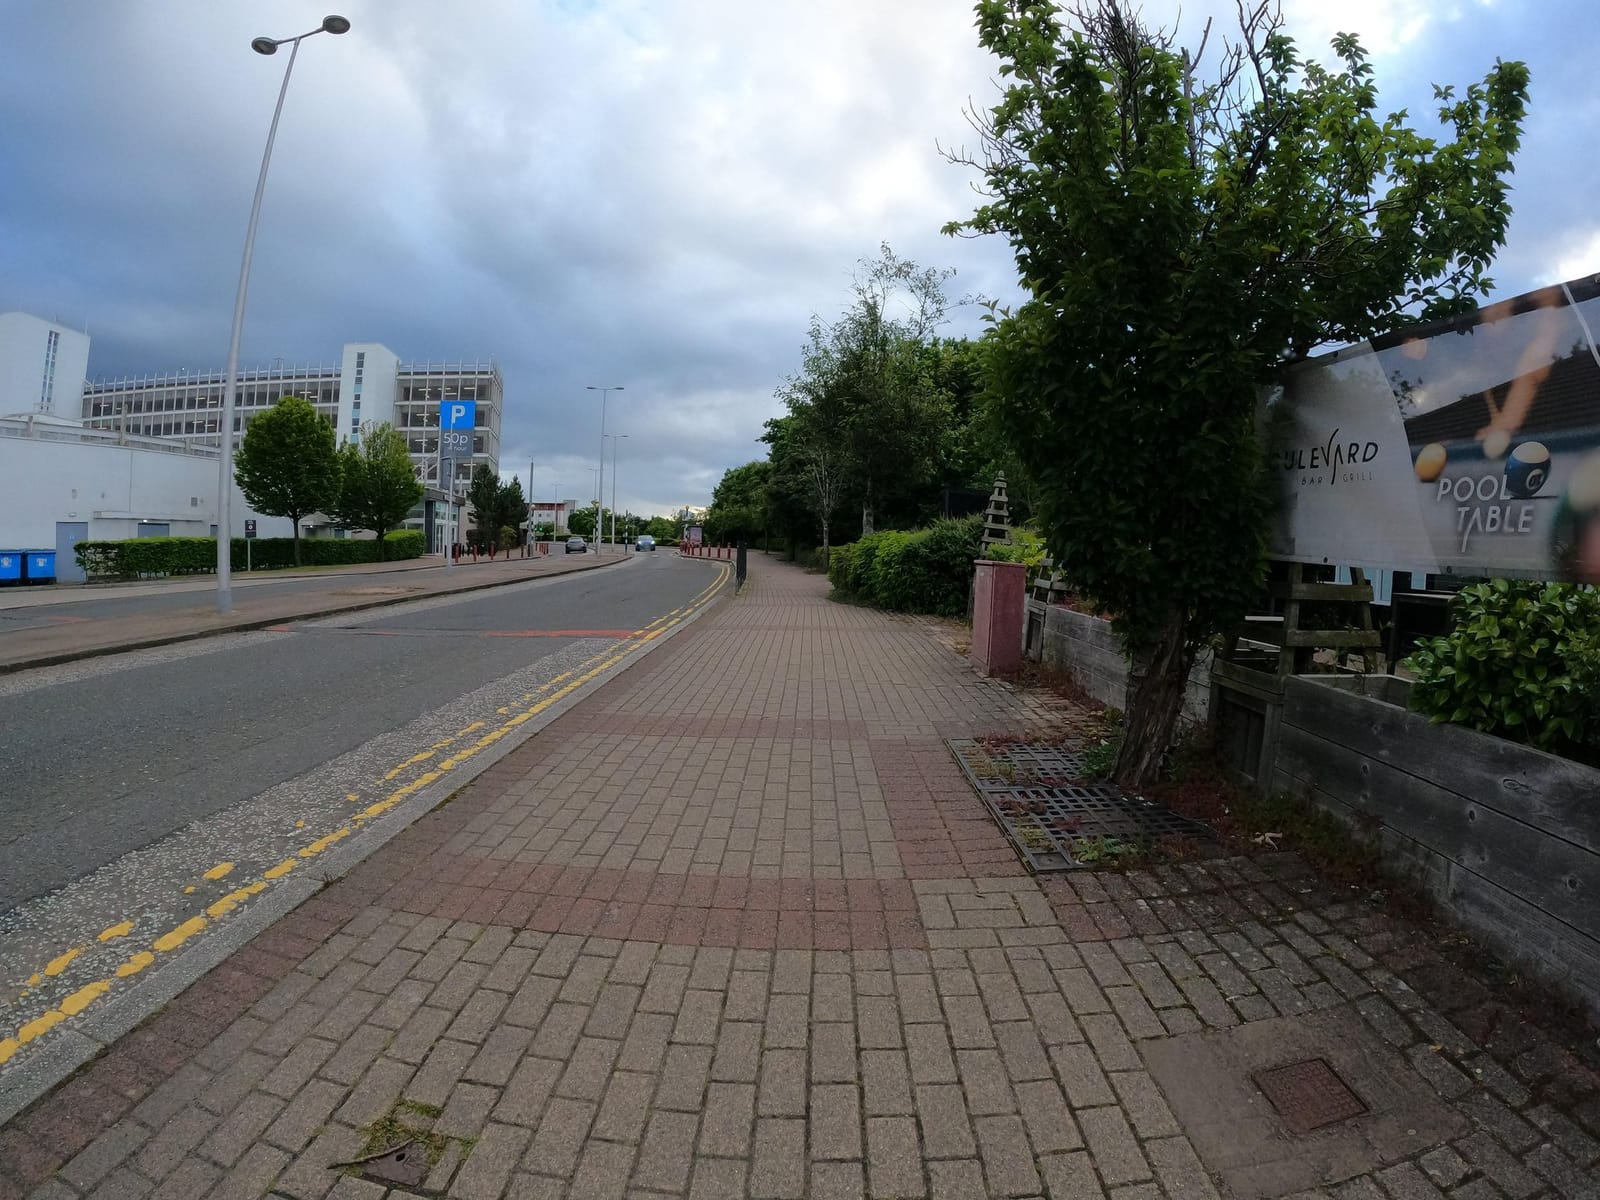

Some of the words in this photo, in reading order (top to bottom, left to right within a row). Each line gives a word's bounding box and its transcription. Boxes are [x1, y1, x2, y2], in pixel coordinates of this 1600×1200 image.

[452, 405, 466, 423] P
[443, 433, 468, 445] 50p
[1437, 474, 1512, 502] POOL
[1457, 504, 1534, 553] TABLE
